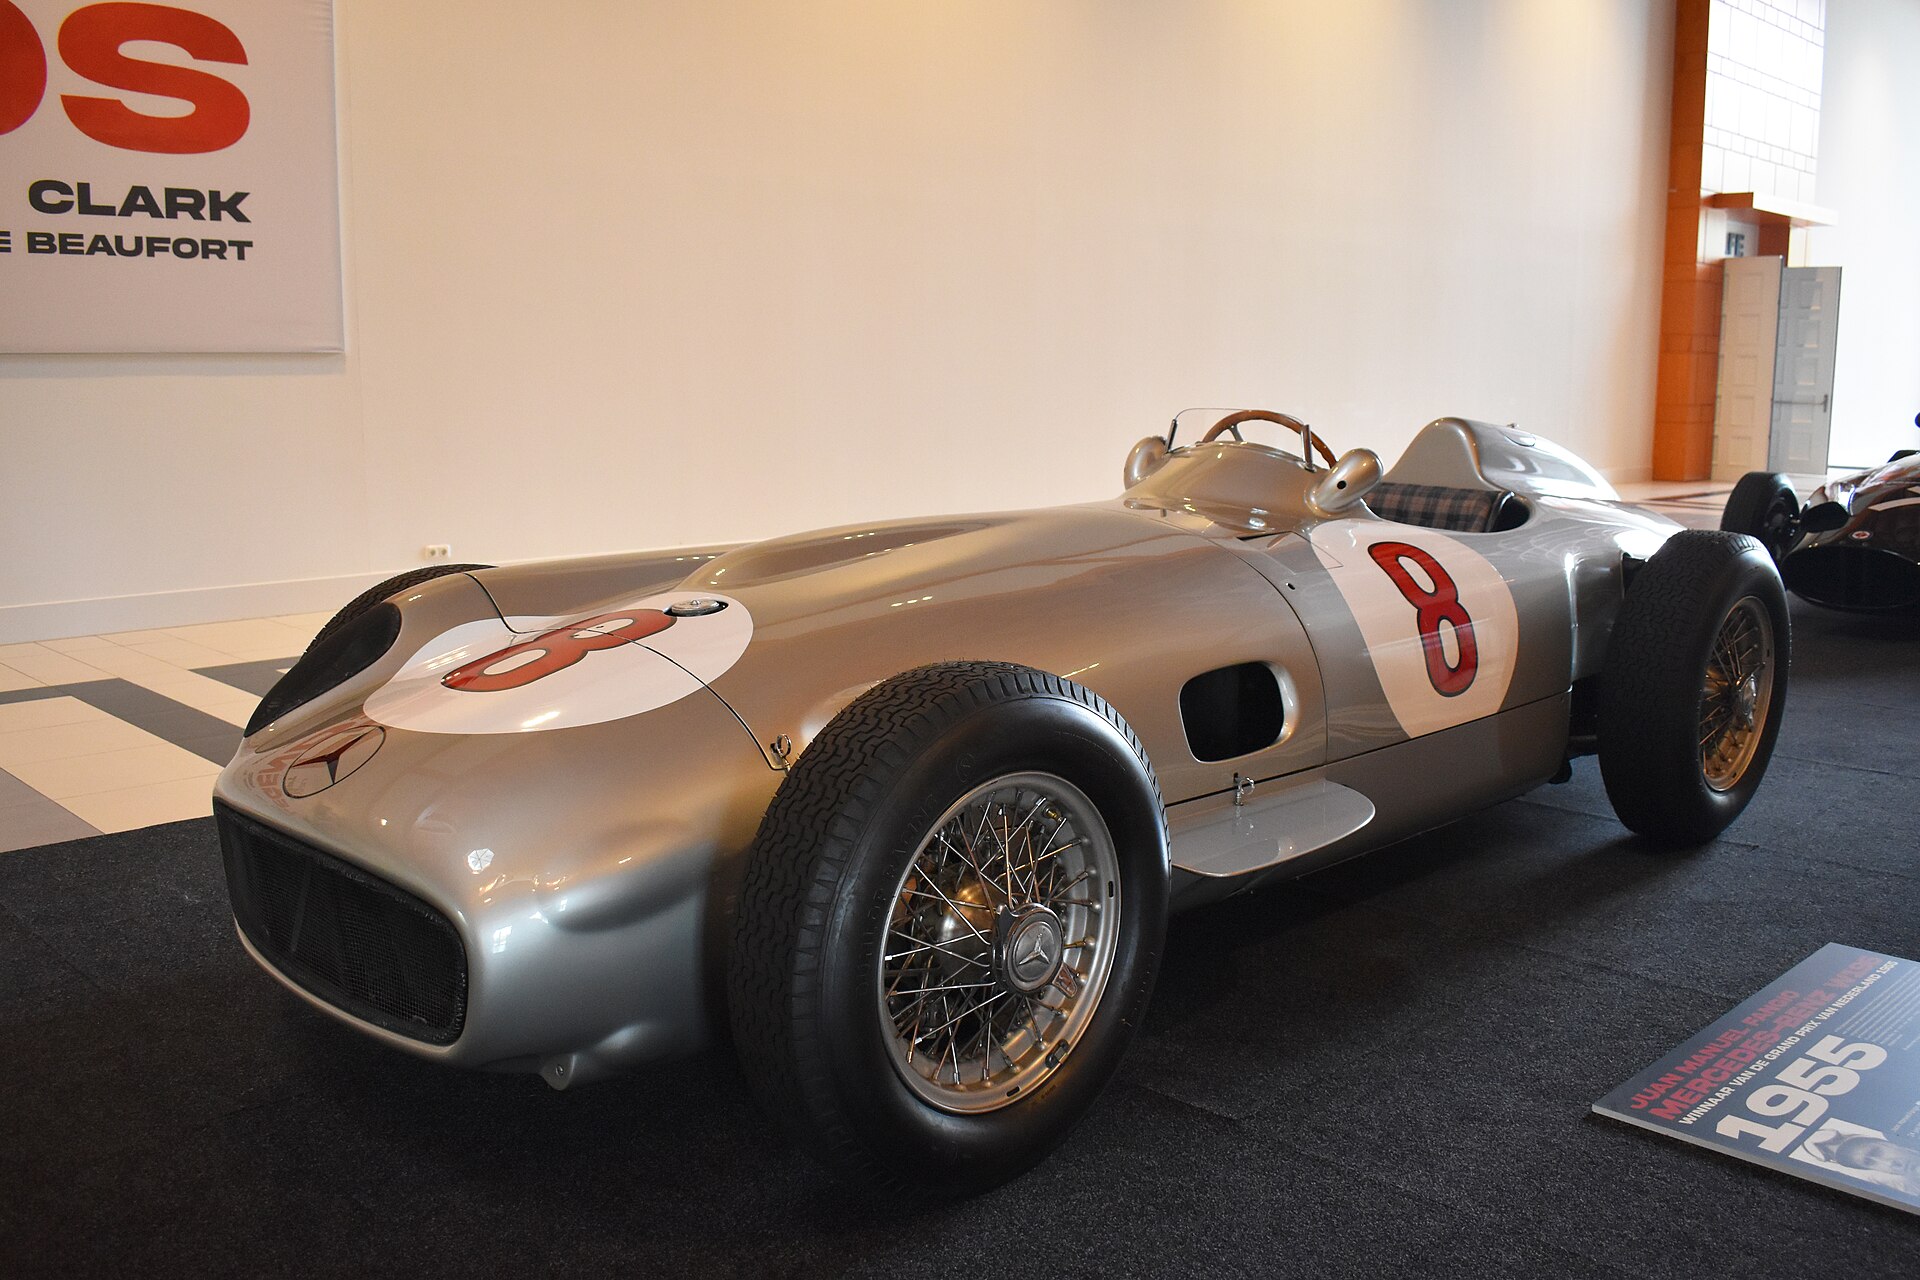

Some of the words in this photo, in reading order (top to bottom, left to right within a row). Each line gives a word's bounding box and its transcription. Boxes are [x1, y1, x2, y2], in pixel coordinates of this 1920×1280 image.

[0, 0, 250, 154] S
[26, 231, 253, 260] BEAUFORT
[28, 179, 251, 223] CLARK
[441, 608, 677, 692] 8
[1367, 541, 1479, 697] 8
[1630, 1073, 1685, 1109] JUAN
[1674, 1028, 1751, 1074] MANUEL
[1678, 1086, 1736, 1125] WINNAAR
[1729, 1070, 1757, 1086] VAN
[1749, 1059, 1770, 1072] DE
[1764, 1035, 1801, 1060] GRAND
[1795, 1019, 1822, 1037] PRIX
[1815, 1006, 1839, 1020] VAN
[1832, 973, 1882, 1008] NEDERLAND
[1716, 1034, 1888, 1154] 1955
